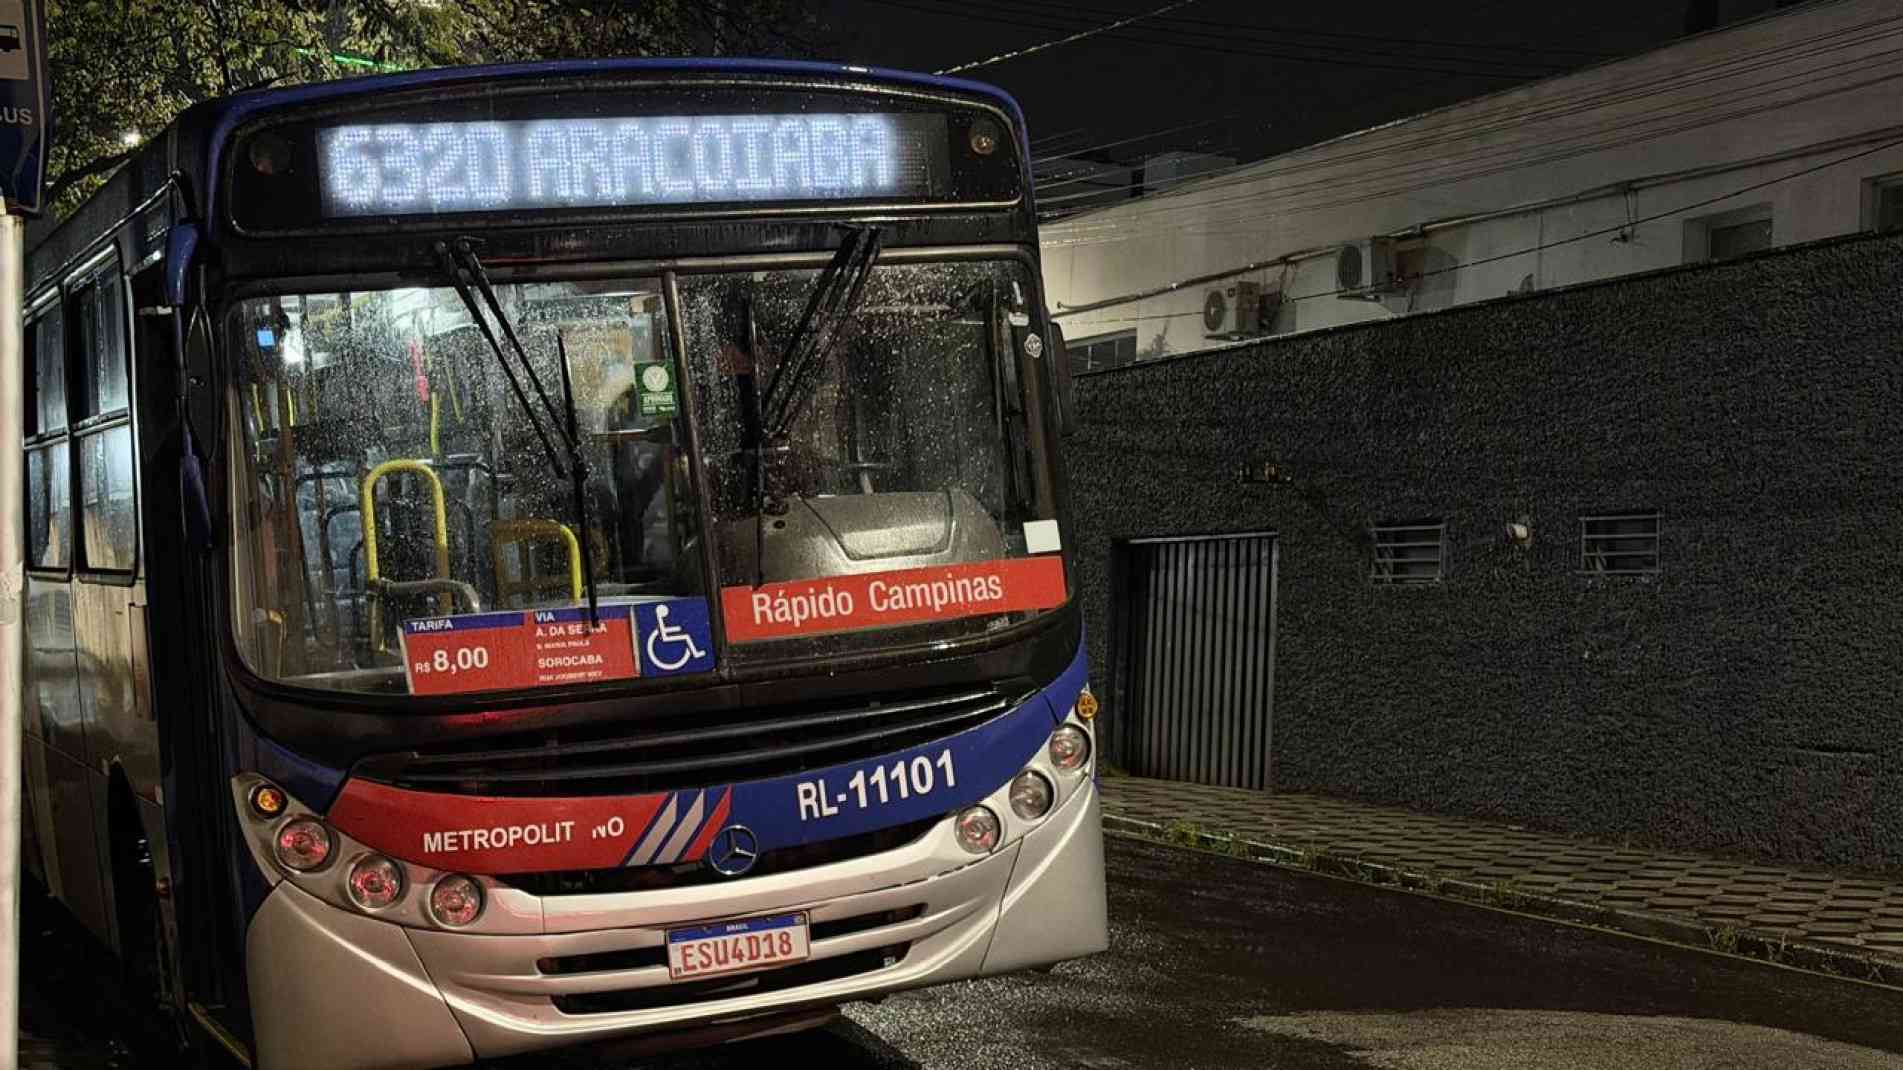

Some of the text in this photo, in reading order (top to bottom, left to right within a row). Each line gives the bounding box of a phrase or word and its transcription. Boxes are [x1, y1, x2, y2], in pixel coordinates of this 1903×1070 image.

[0, 106, 33, 125] US
[327, 119, 889, 203] 6320 ARACOIABA
[751, 573, 1003, 627] Rápido Campinas
[412, 619, 454, 632] TARIFA
[535, 611, 555, 622] VIA
[549, 625, 565, 637] DA
[568, 622, 608, 635] SEA
[416, 647, 489, 674] R$ 8,00
[538, 654, 603, 669] SOROCABA
[797, 749, 955, 821] RL-11101
[423, 816, 625, 853] METROPOLITNO
[681, 931, 793, 972] ESU4D18
